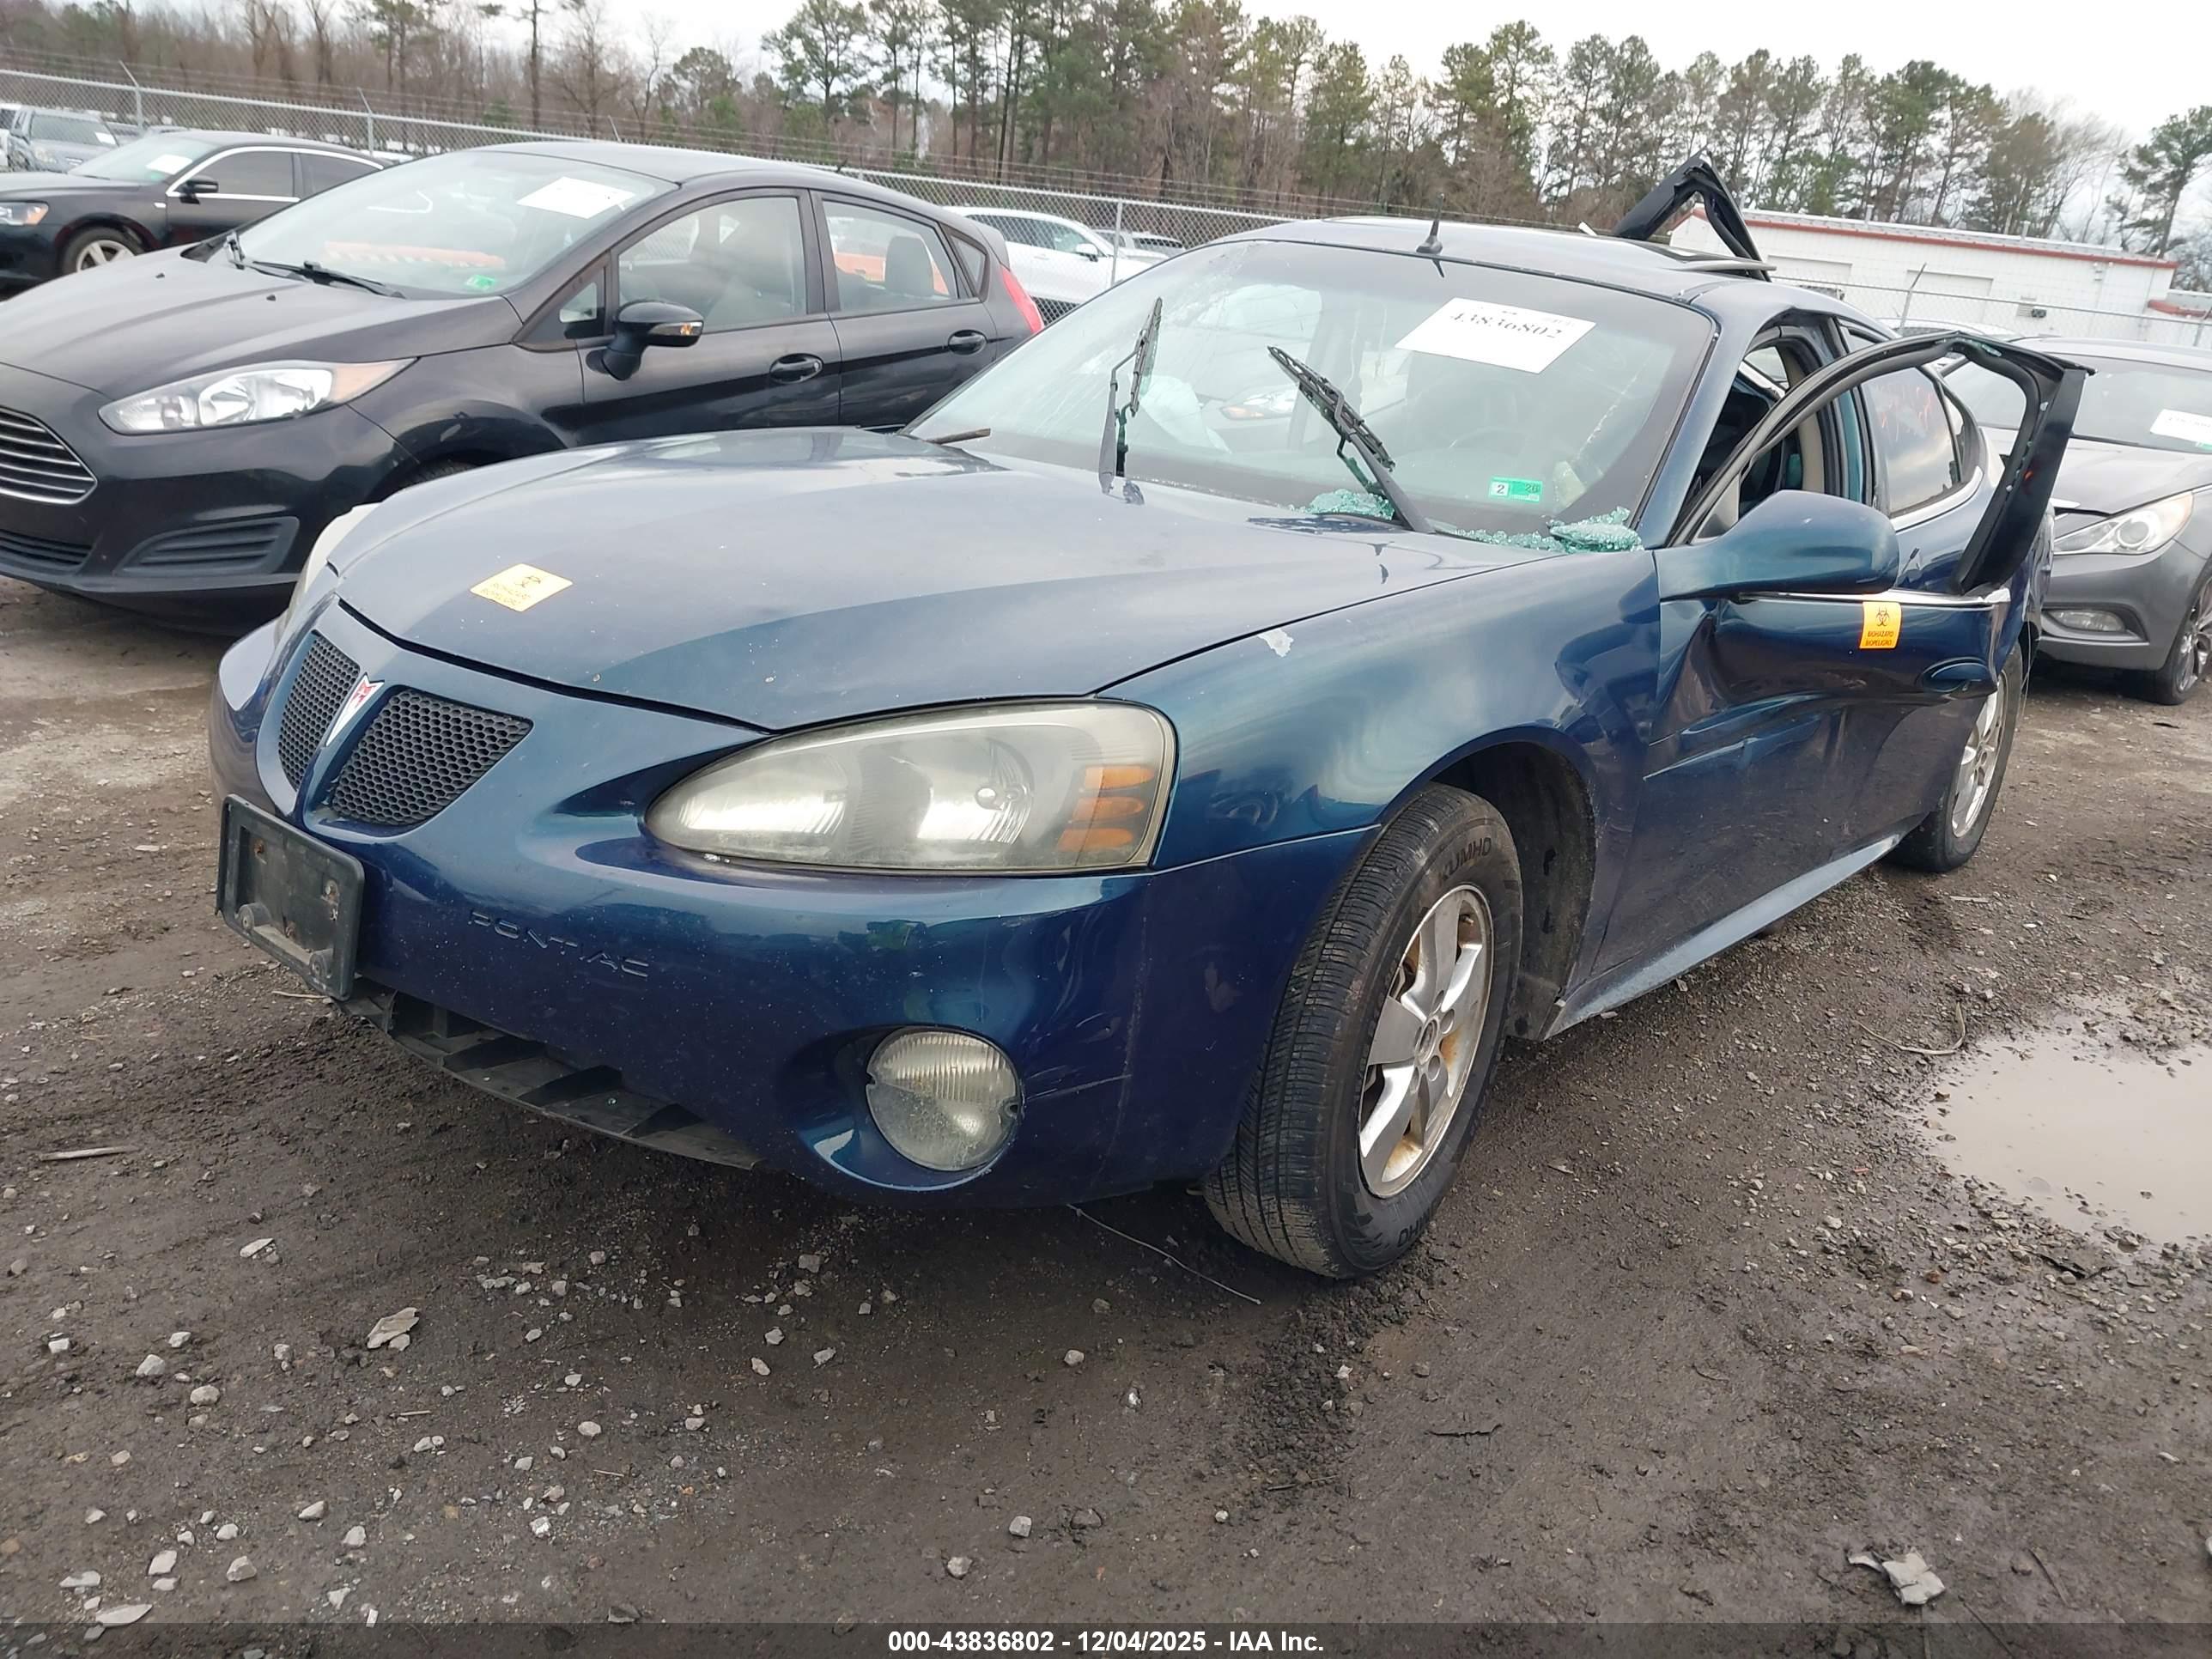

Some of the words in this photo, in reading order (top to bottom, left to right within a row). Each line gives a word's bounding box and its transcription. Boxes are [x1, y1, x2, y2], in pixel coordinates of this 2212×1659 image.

[1450, 312, 1563, 338] 43836802
[1497, 483, 1505, 494] 2
[469, 909, 649, 977] PONTIAC
